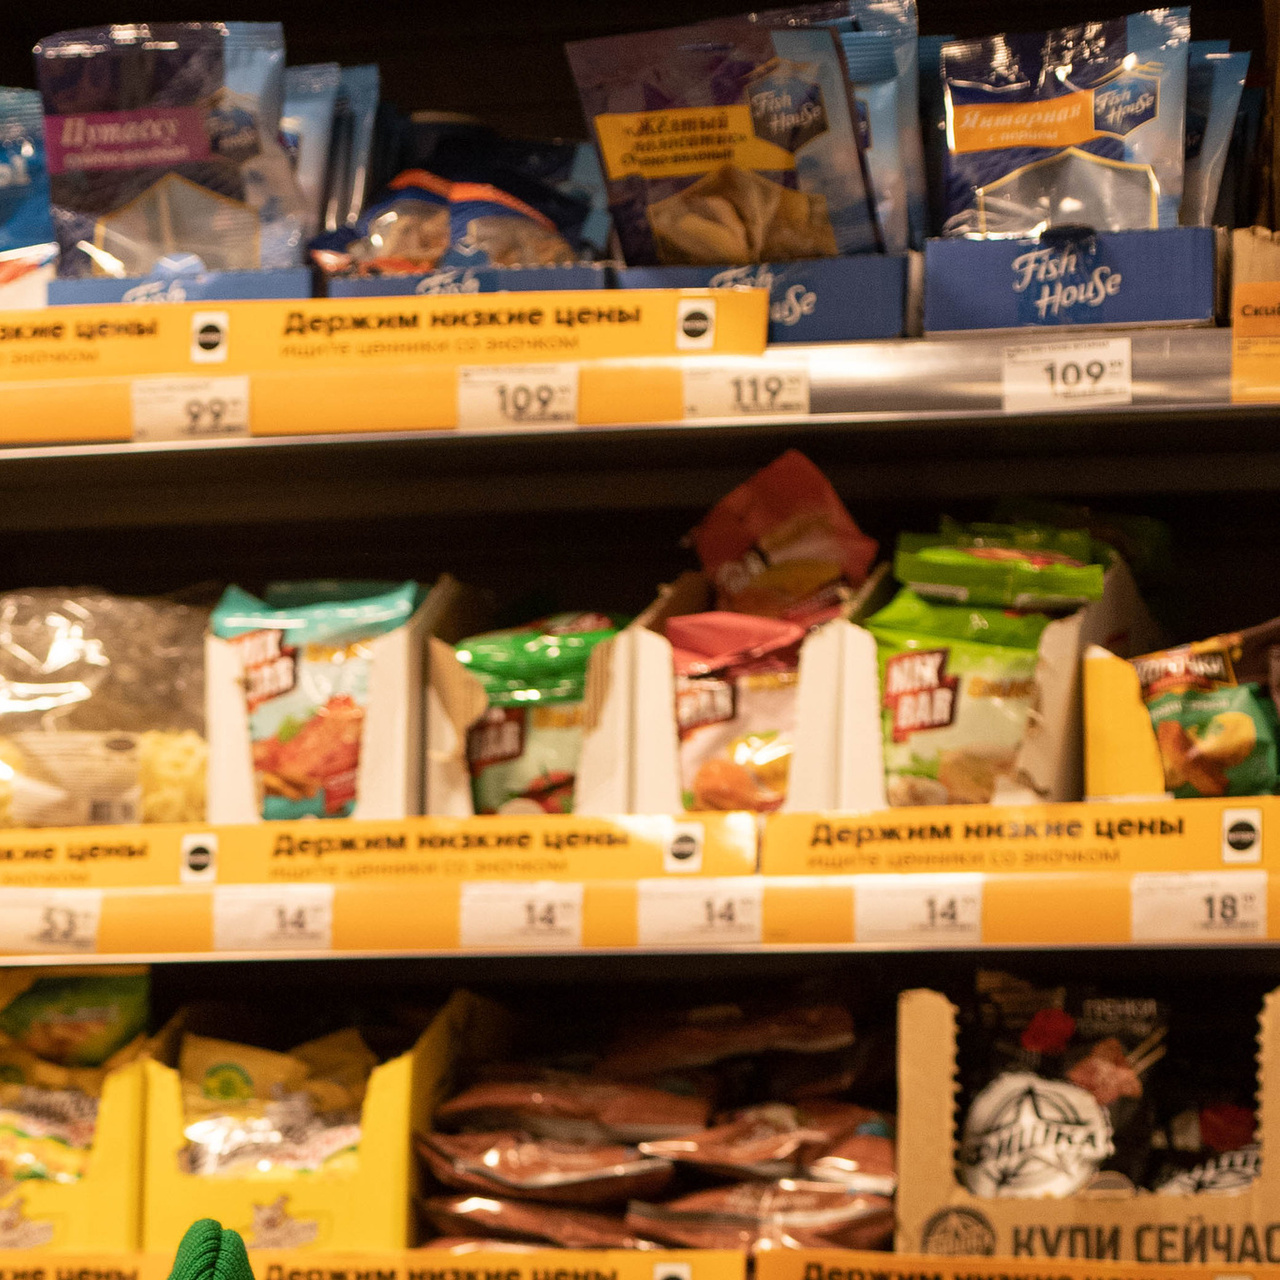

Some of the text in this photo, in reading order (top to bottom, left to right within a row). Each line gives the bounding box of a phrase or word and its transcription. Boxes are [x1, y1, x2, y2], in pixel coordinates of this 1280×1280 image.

[1011, 246, 1077, 293] Fish
[282, 304, 642, 336] Держим низкие цены
[731, 376, 783, 408] 119
[1044, 360, 1107, 392] 109
[496, 384, 554, 415] 109
[271, 832, 407, 859] Держим
[416, 830, 532, 851] низкие
[809, 815, 1185, 850] Держим низкие цены
[925, 896, 958, 925] 14
[1202, 893, 1238, 922] 18
[1012, 1225, 1121, 1262] КУПИ
